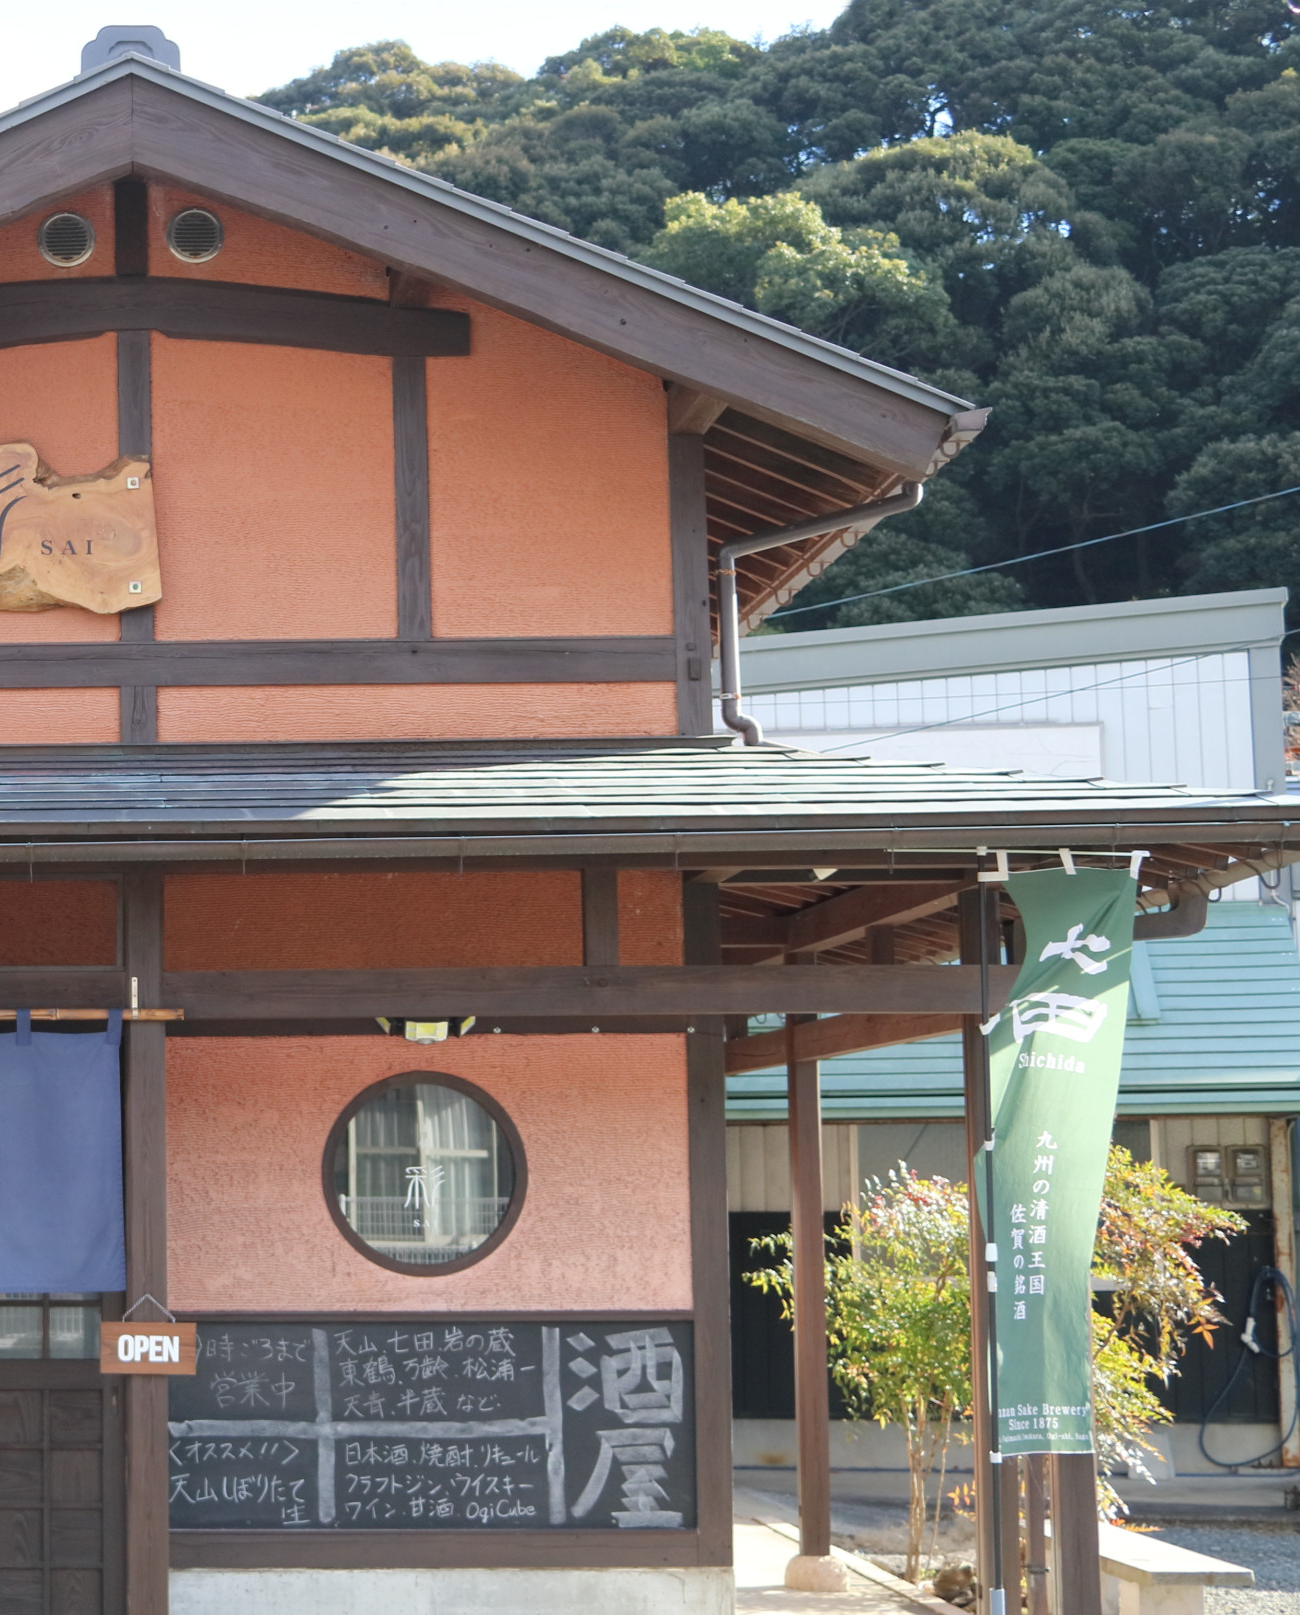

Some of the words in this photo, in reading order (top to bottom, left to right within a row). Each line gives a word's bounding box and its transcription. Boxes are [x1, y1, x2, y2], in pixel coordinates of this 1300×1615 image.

[40, 540, 93, 555] SAI
[1009, 922, 1111, 1043] 七田
[1018, 1051, 1086, 1074] Shichida
[404, 1165, 445, 1210] 彩
[413, 1219, 438, 1228] SAI
[1028, 1130, 1058, 1296] 九州の清酒王国
[1010, 1203, 1027, 1320] 佐賀の銘酒
[118, 1335, 180, 1362] OPEN
[195, 1333, 312, 1364] 時ごろまで
[210, 1370, 296, 1411] 営業中
[1008, 1419, 1030, 1431] Since
[1033, 1417, 1059, 1430] 1875
[1017, 1404, 1038, 1416] Sake
[1042, 1403, 1087, 1417] Brewery
[567, 1326, 685, 1529] 酒屋
[168, 1473, 306, 1504] 天山しぼりたて
[281, 1504, 311, 1525] 生
